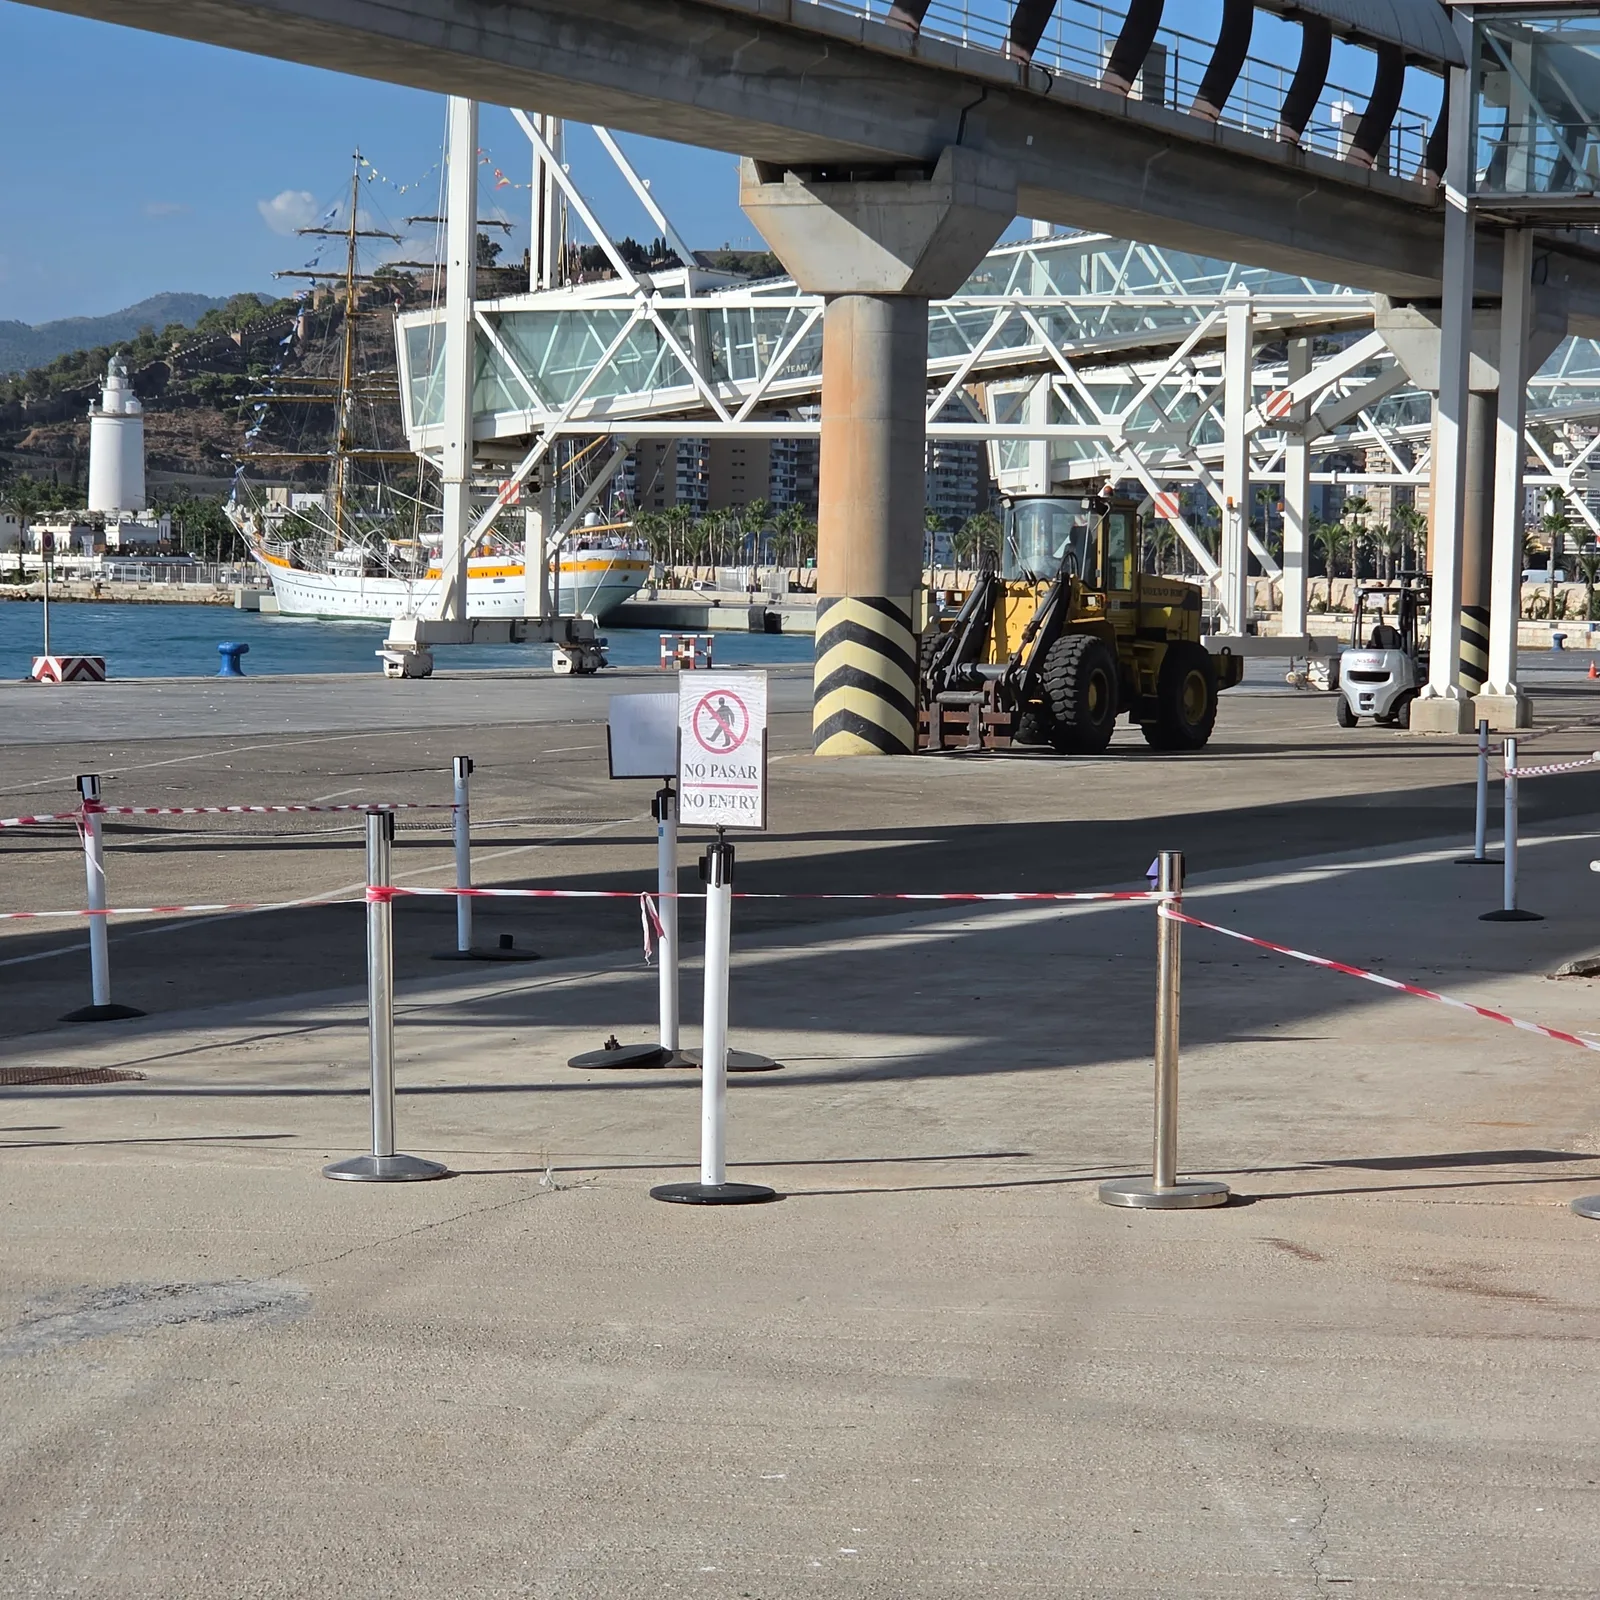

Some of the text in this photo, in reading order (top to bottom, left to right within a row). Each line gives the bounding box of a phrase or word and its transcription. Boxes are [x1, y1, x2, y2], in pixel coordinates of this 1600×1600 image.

[786, 363, 808, 373] TEAM
[1142, 587, 1169, 596] VOLVO
[684, 763, 758, 779] NO PASAR
[683, 793, 759, 809] NO ENTRY
